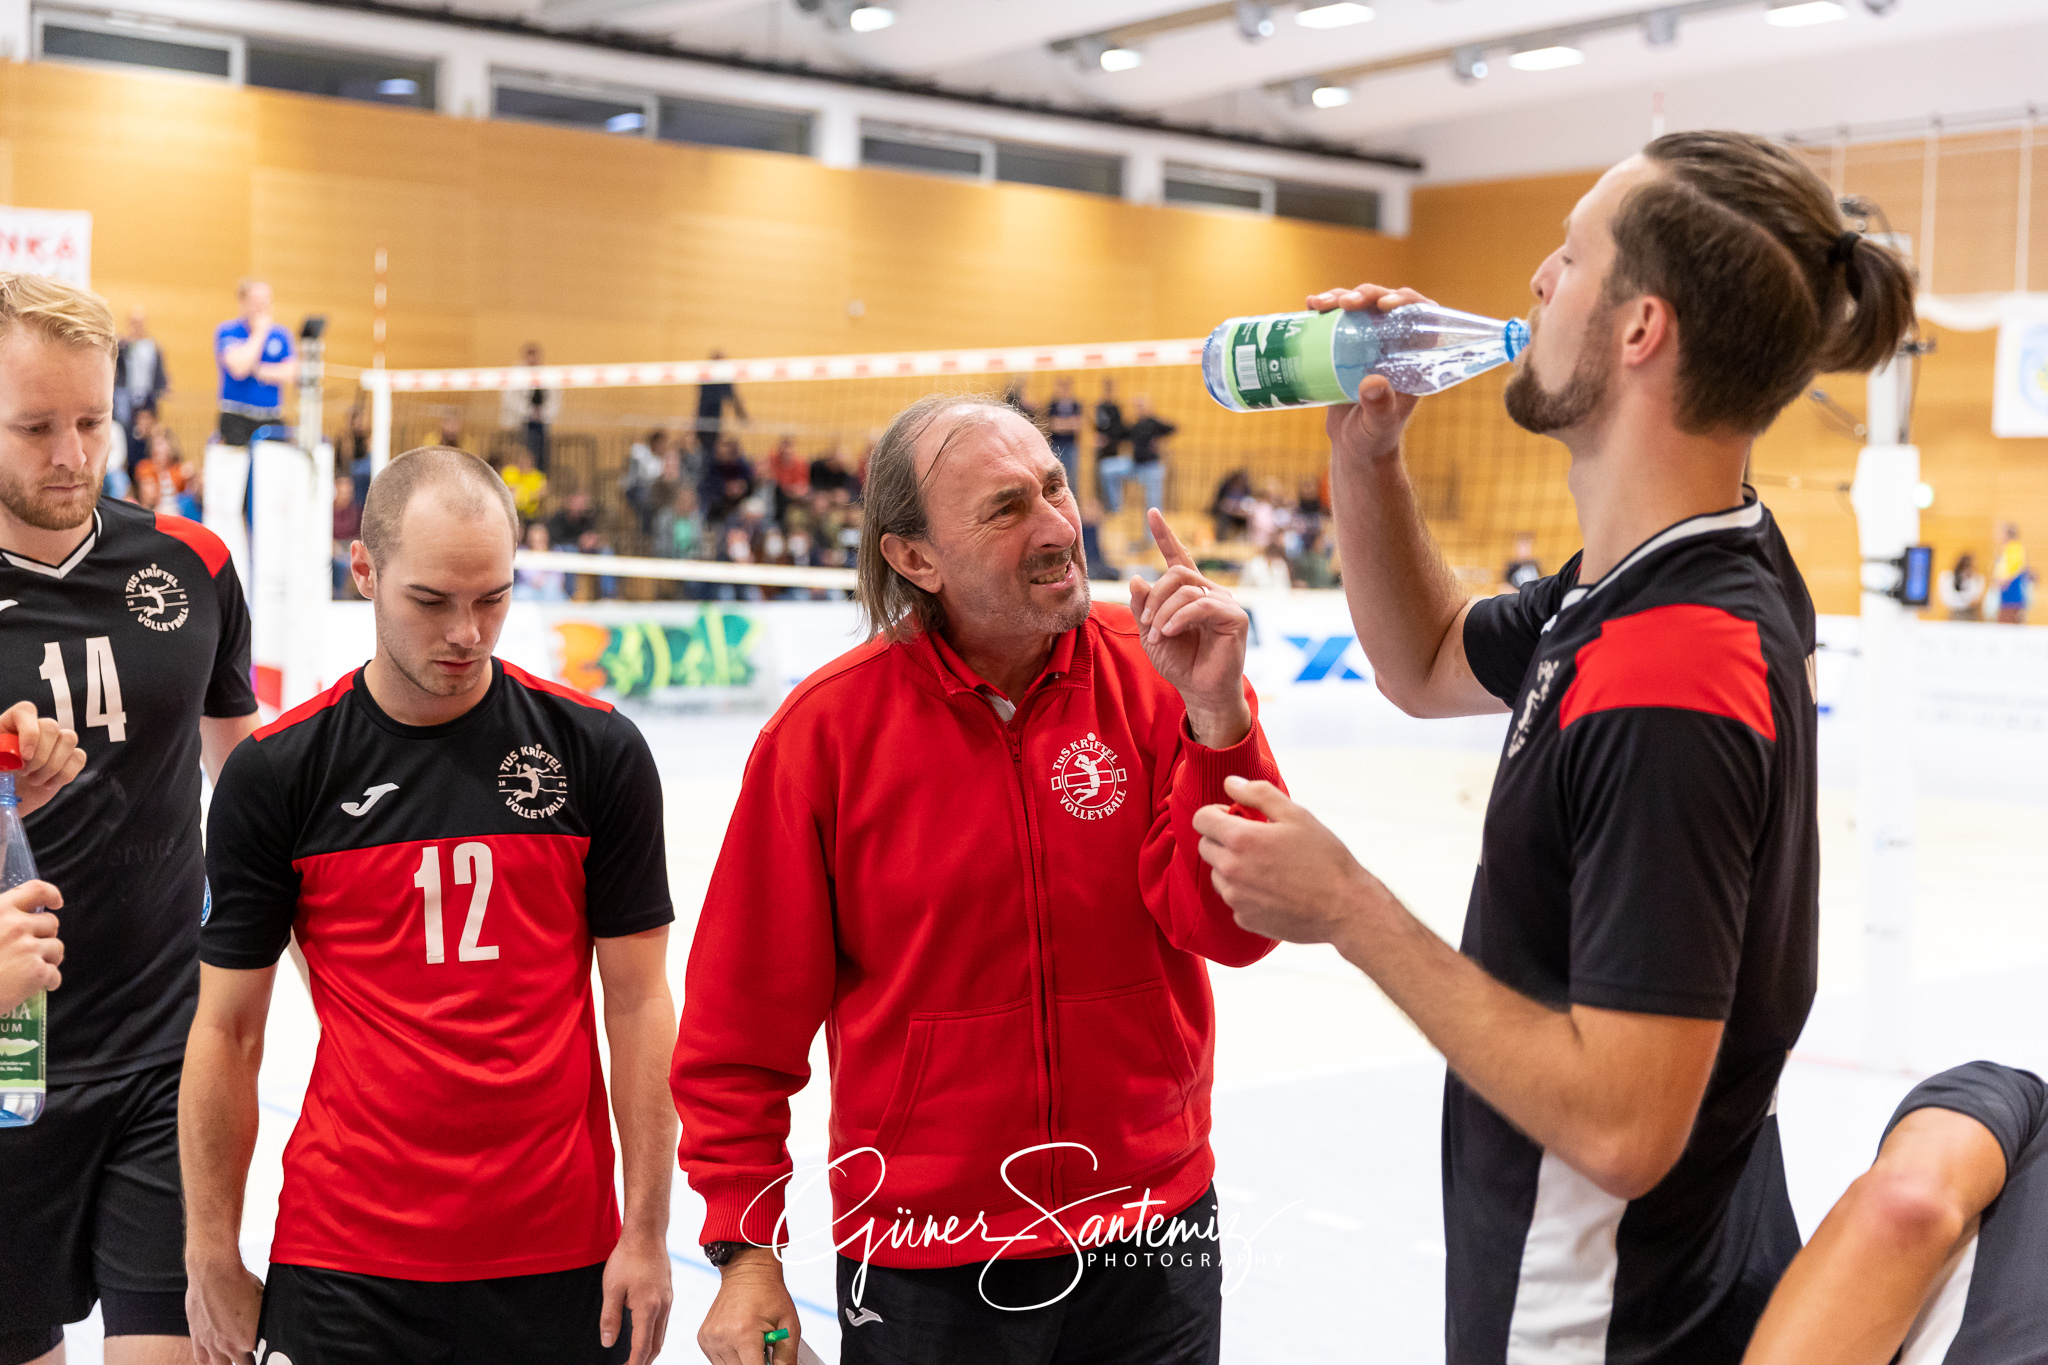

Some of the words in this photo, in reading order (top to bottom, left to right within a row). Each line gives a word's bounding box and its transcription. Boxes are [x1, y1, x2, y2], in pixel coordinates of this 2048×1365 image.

[125, 574, 140, 593] TUS
[138, 563, 179, 588] KRIFTEL
[137, 607, 190, 632] VOLLEYBALL
[39, 636, 127, 743] 14
[499, 750, 520, 772] TUS
[520, 743, 562, 774] KRIFTEL
[1069, 732, 1118, 764] KRIFTEL
[505, 796, 566, 819] VOLLEYBALL
[1060, 789, 1127, 820] VOLLEYBALL
[413, 841, 500, 965] 12
